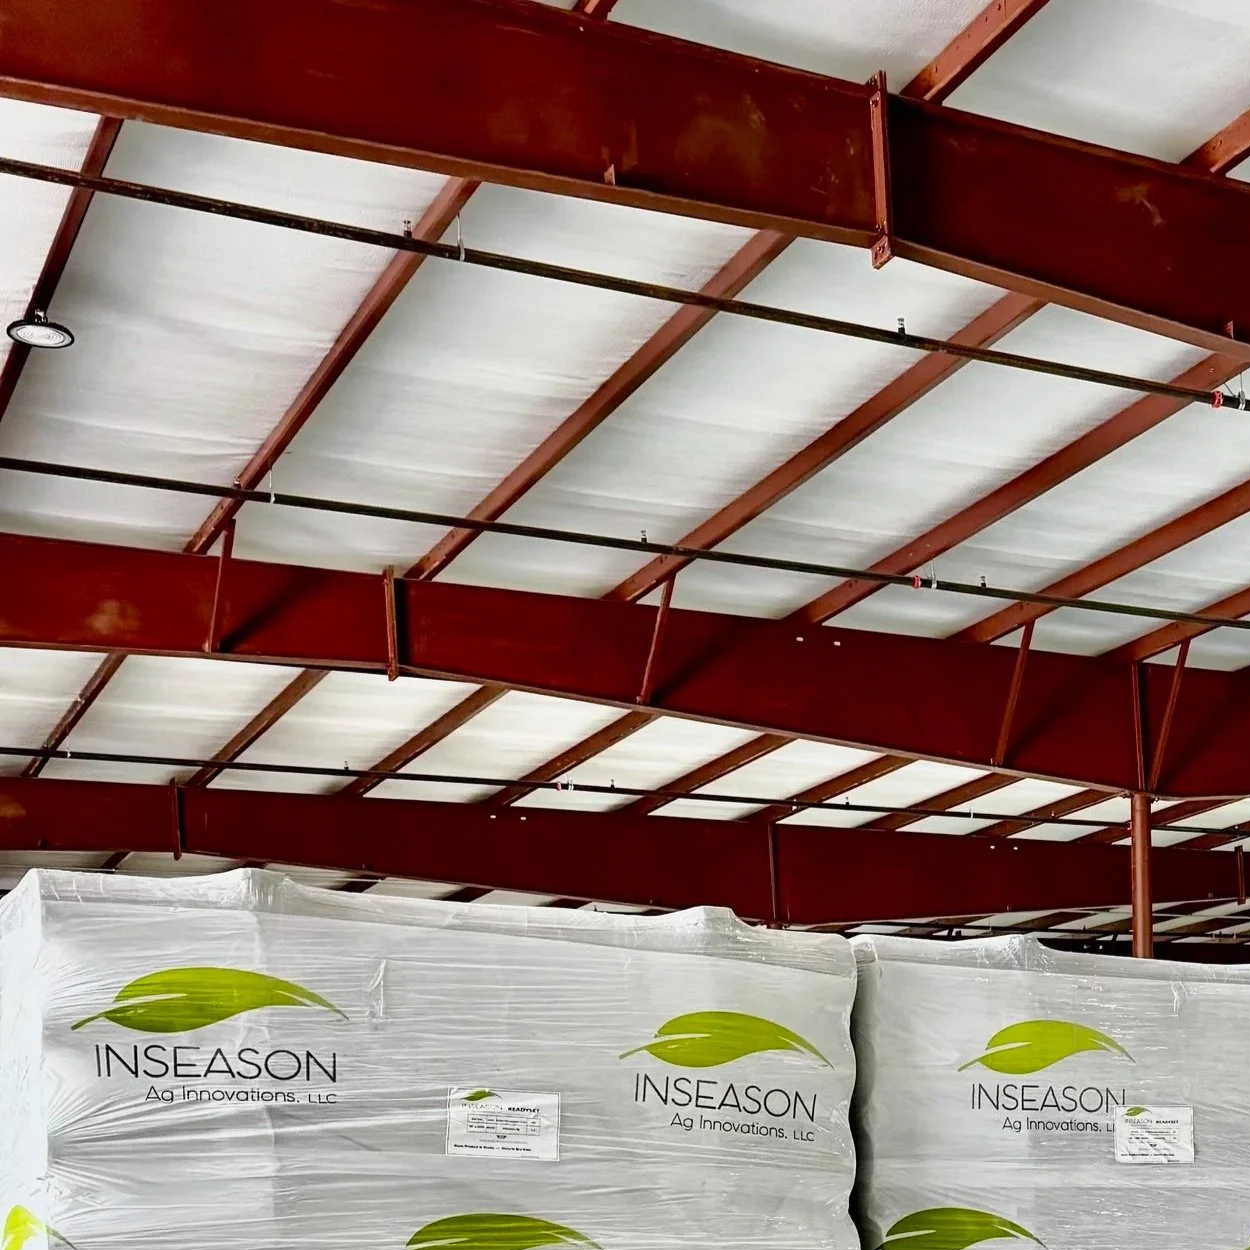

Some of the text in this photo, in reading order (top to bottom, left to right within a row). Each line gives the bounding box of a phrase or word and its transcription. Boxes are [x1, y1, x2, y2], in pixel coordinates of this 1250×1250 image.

[95, 1044, 337, 1083] INSEASON
[145, 1085, 174, 1105] Ag
[308, 1093, 337, 1104] LLC
[635, 1073, 817, 1122] INSEASON
[971, 1083, 1126, 1113] INSEASON
[670, 1112, 694, 1131] Ag
[793, 1130, 815, 1142] LLC
[1002, 1116, 1022, 1133] Ag
